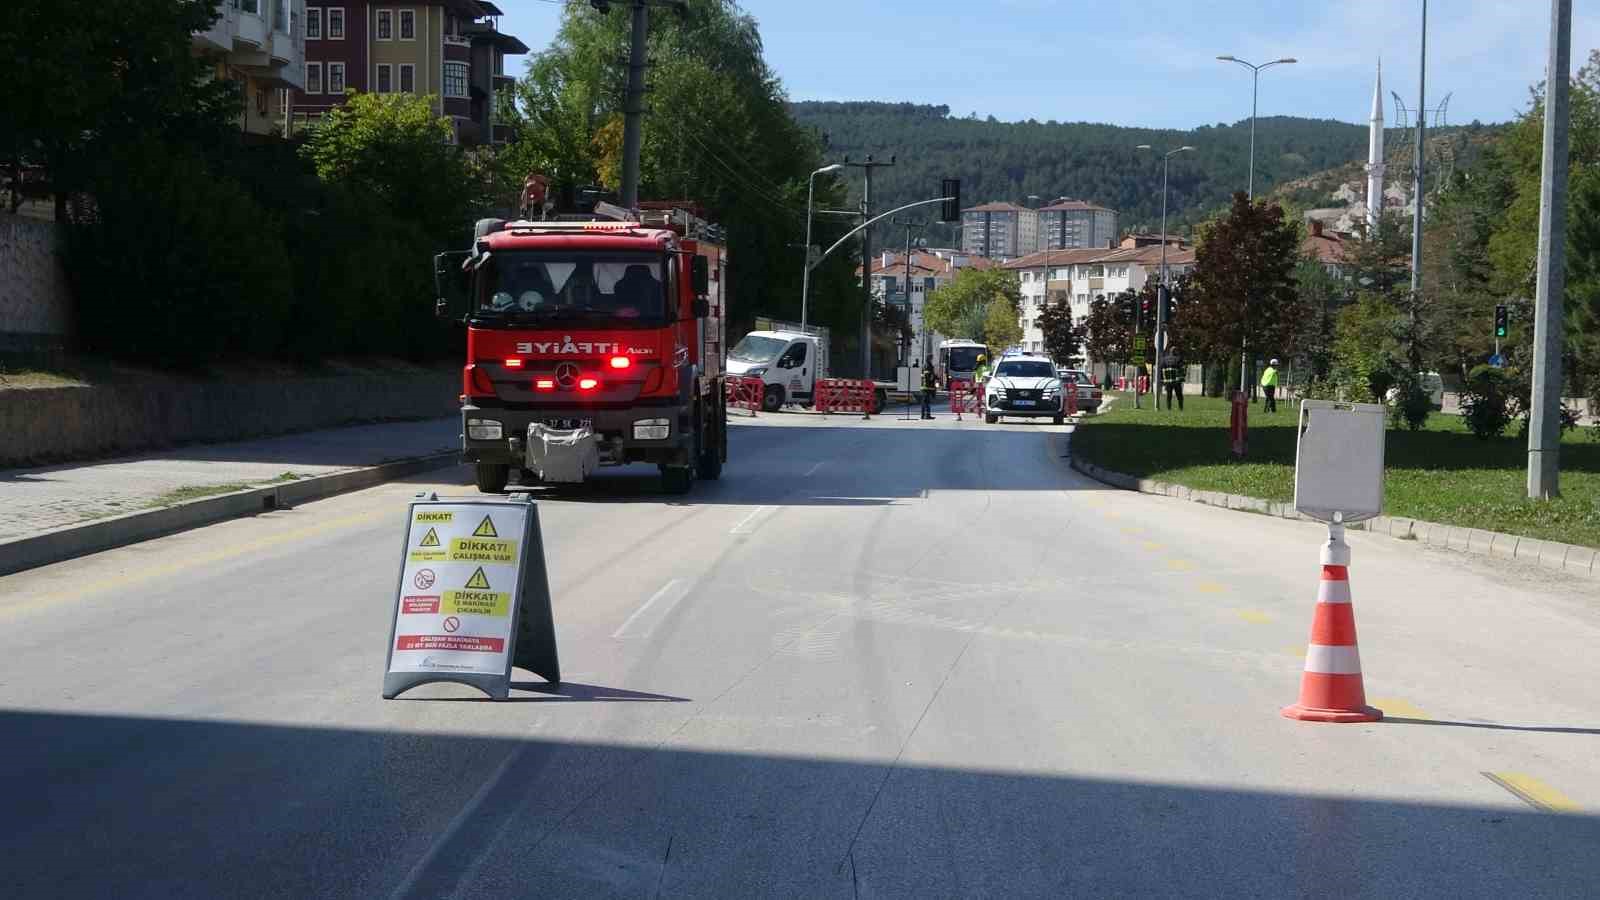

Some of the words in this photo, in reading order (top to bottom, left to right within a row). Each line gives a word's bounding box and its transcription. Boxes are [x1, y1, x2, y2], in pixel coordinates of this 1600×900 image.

[417, 512, 452, 521] DİKKAT!
[460, 540, 508, 552] DİKKAT!
[453, 552, 491, 562] ÇALIŞMA
[494, 553, 511, 561] VAR
[455, 591, 498, 601] DİKKAT!
